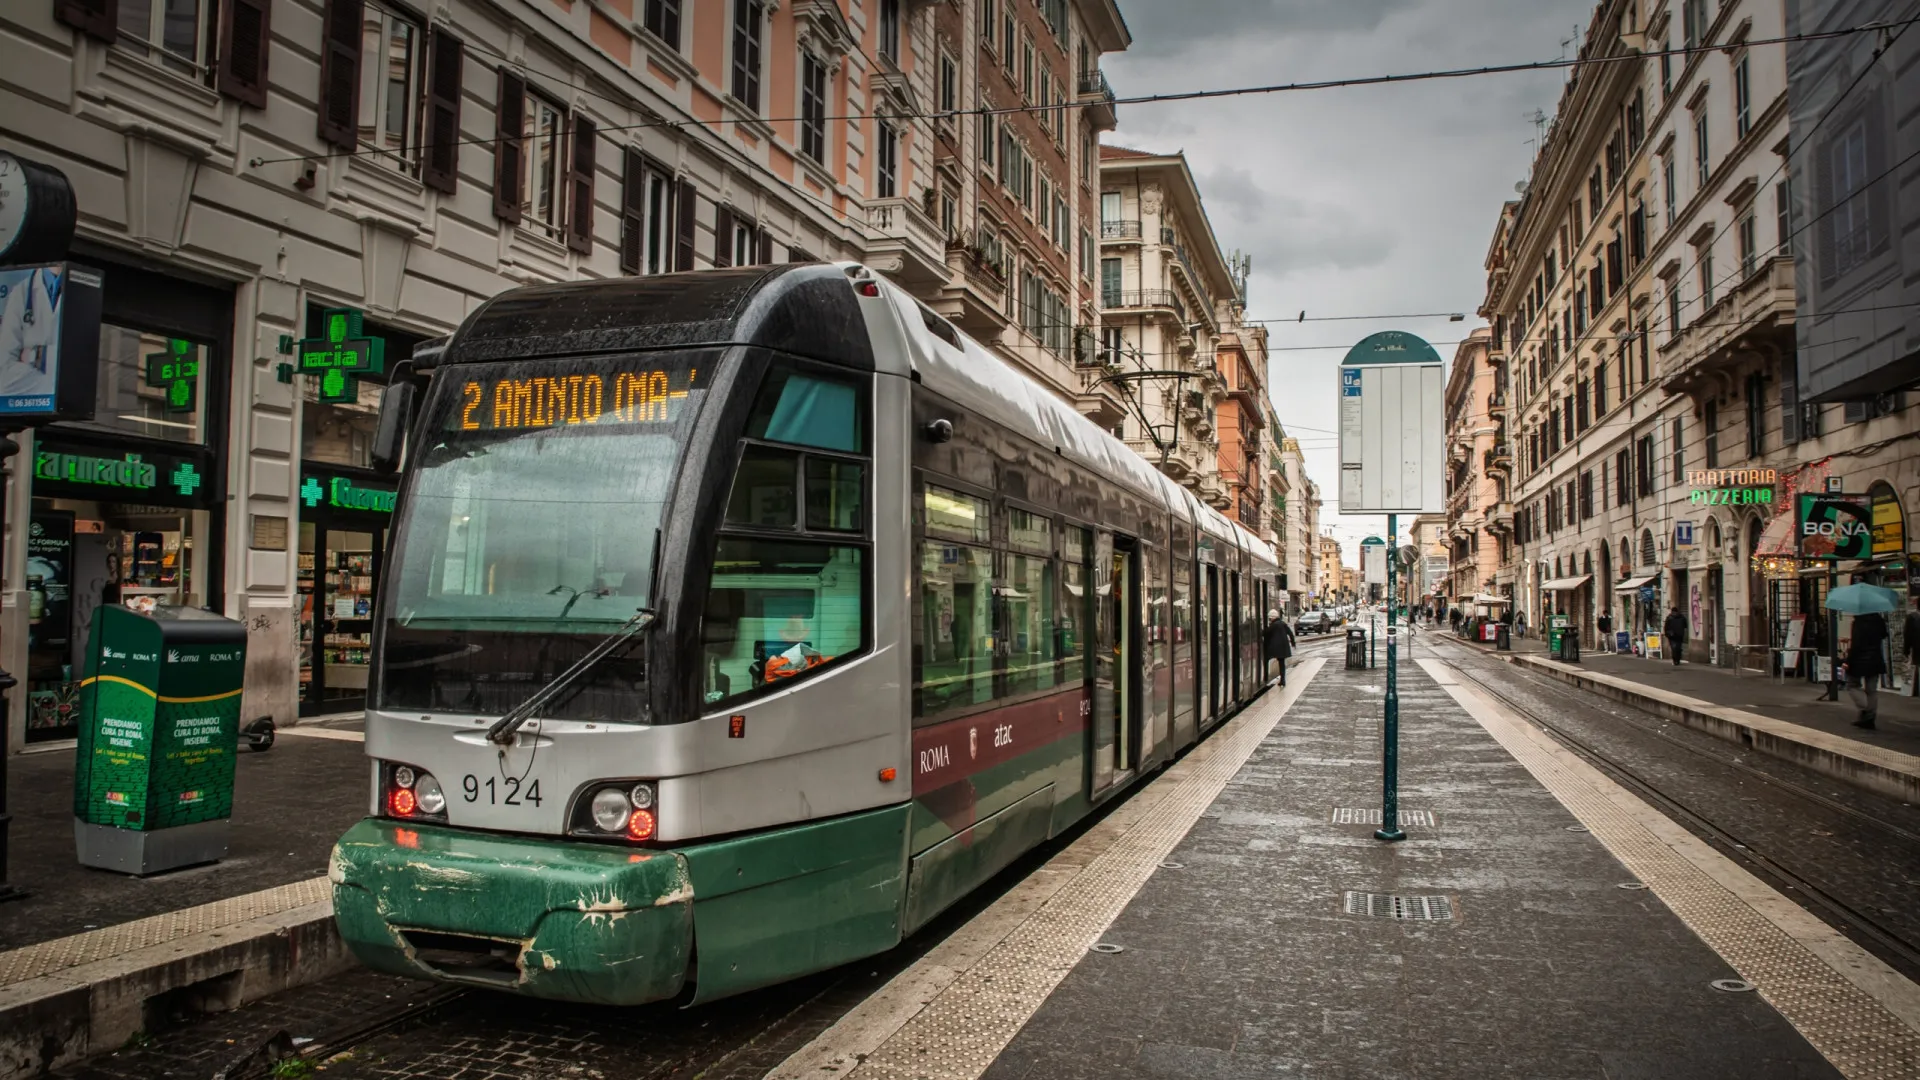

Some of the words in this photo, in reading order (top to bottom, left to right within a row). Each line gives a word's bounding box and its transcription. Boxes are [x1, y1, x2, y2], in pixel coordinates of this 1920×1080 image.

[463, 381, 481, 431] 2
[494, 374, 603, 429] AMINIO
[1687, 469, 1777, 486] TRATTORIA
[1691, 488, 1773, 505] PIZZERIA
[1803, 522, 1870, 536] BONA
[37, 539, 70, 547] FORMULA
[132, 653, 150, 661] ROMA
[181, 654, 199, 662] ama
[209, 653, 232, 661] ROMA
[103, 718, 142, 730] PRENDIAMOCI
[175, 717, 220, 728] PRENDIAMOCI
[101, 727, 117, 736] CURA
[174, 729, 192, 738] CURA
[193, 728, 199, 736] DI
[994, 724, 1013, 748] atac
[920, 744, 950, 774] ROMA
[463, 774, 543, 807] 9124
